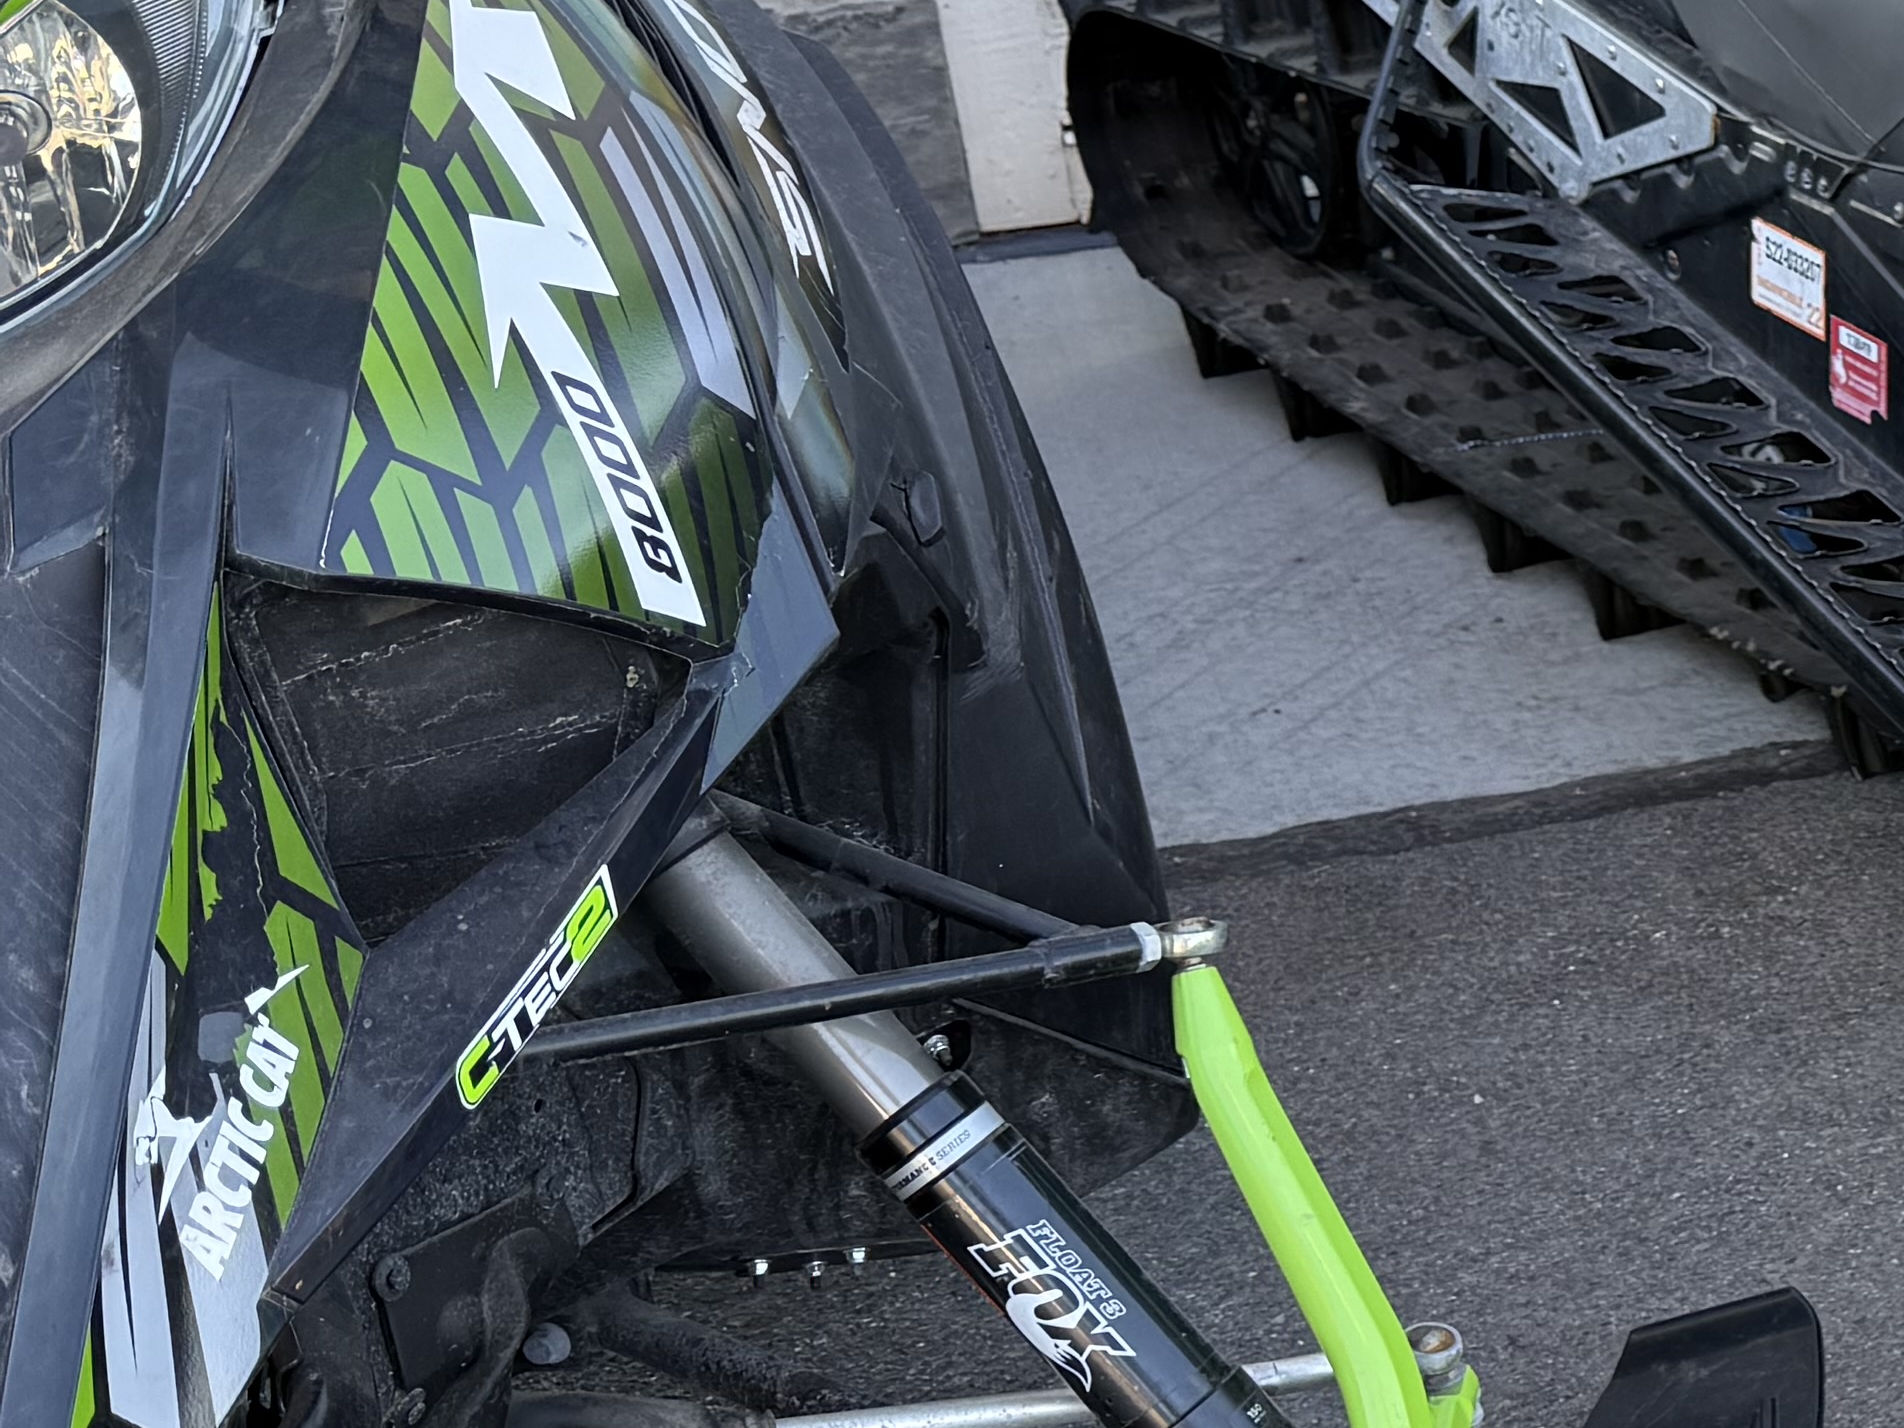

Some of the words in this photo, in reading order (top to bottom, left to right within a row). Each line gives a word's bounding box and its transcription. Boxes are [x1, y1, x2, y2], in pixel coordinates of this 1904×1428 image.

[550, 370, 684, 584] 8000
[179, 1096, 275, 1283] ARCTIC
[239, 1011, 300, 1109] CAT
[935, 1128, 972, 1162] SERIES
[967, 1228, 1137, 1393] FOX
[1026, 1219, 1112, 1302] FLOAT
[1099, 1292, 1127, 1320] 3
